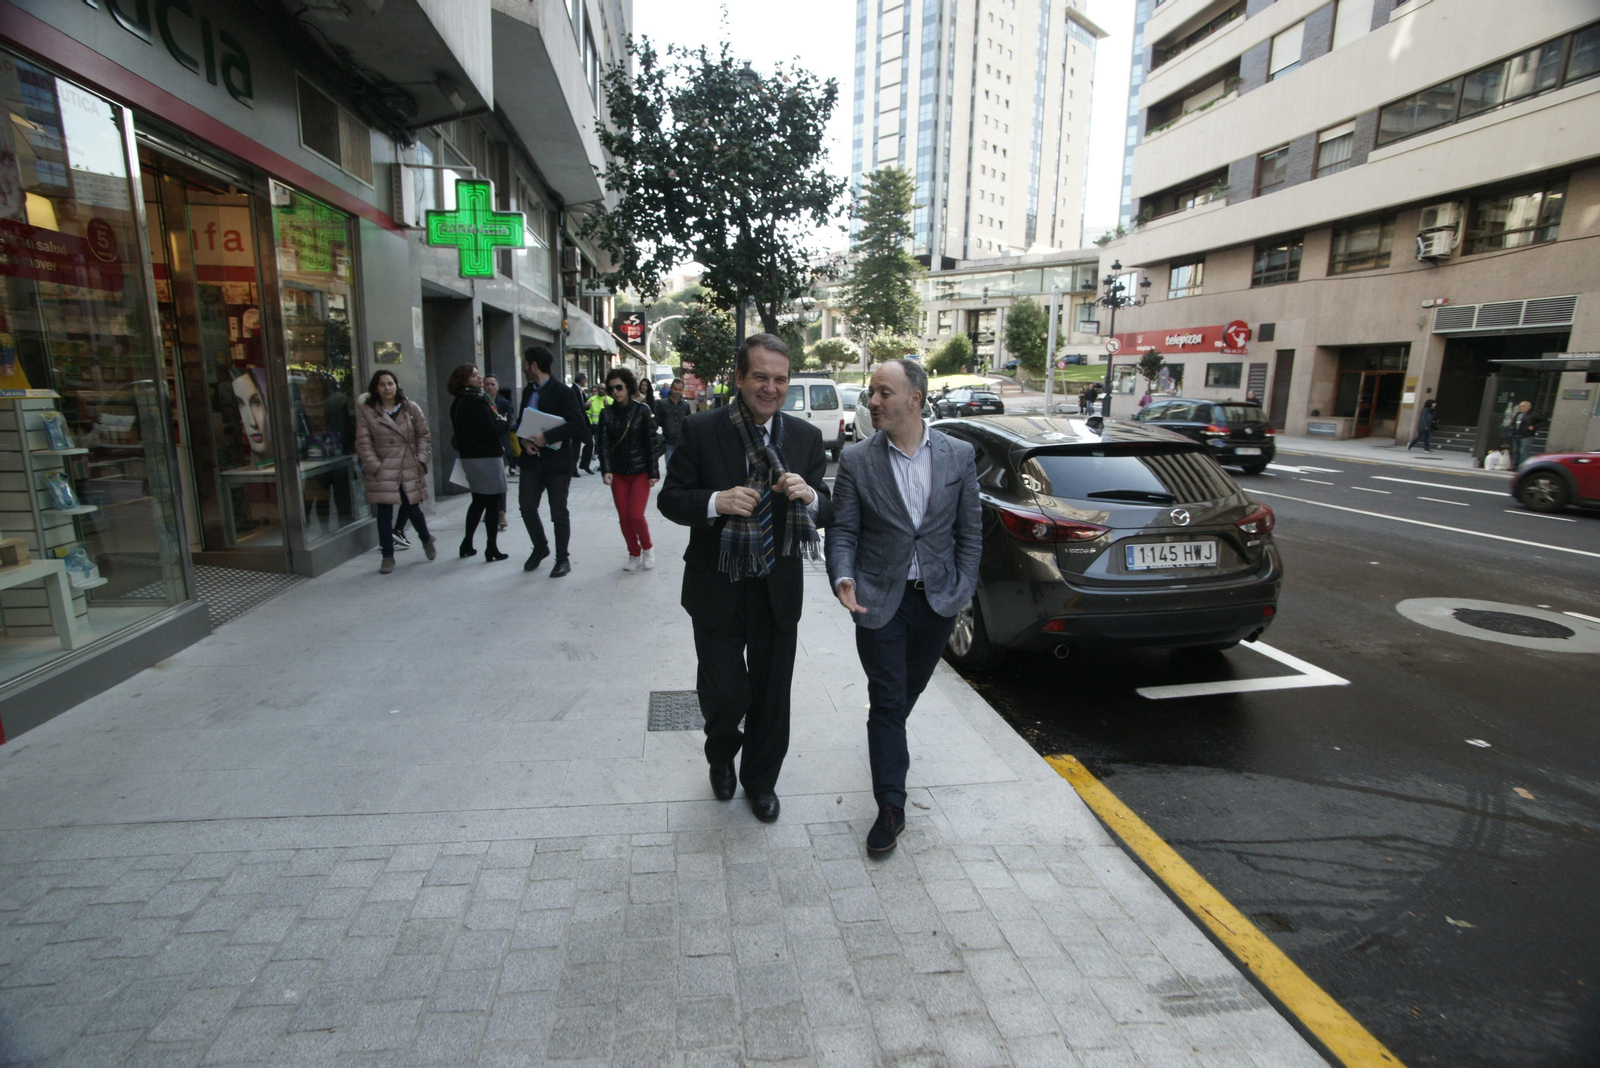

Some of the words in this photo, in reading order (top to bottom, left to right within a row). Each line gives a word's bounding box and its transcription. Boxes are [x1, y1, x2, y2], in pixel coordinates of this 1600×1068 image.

[440, 223, 509, 236] FARMACIA
[36, 240, 69, 257] salud
[22, 256, 57, 272] mover
[1165, 332, 1203, 348] telepizza
[1140, 545, 1178, 563] 1145
[1183, 544, 1213, 561] HWJ
